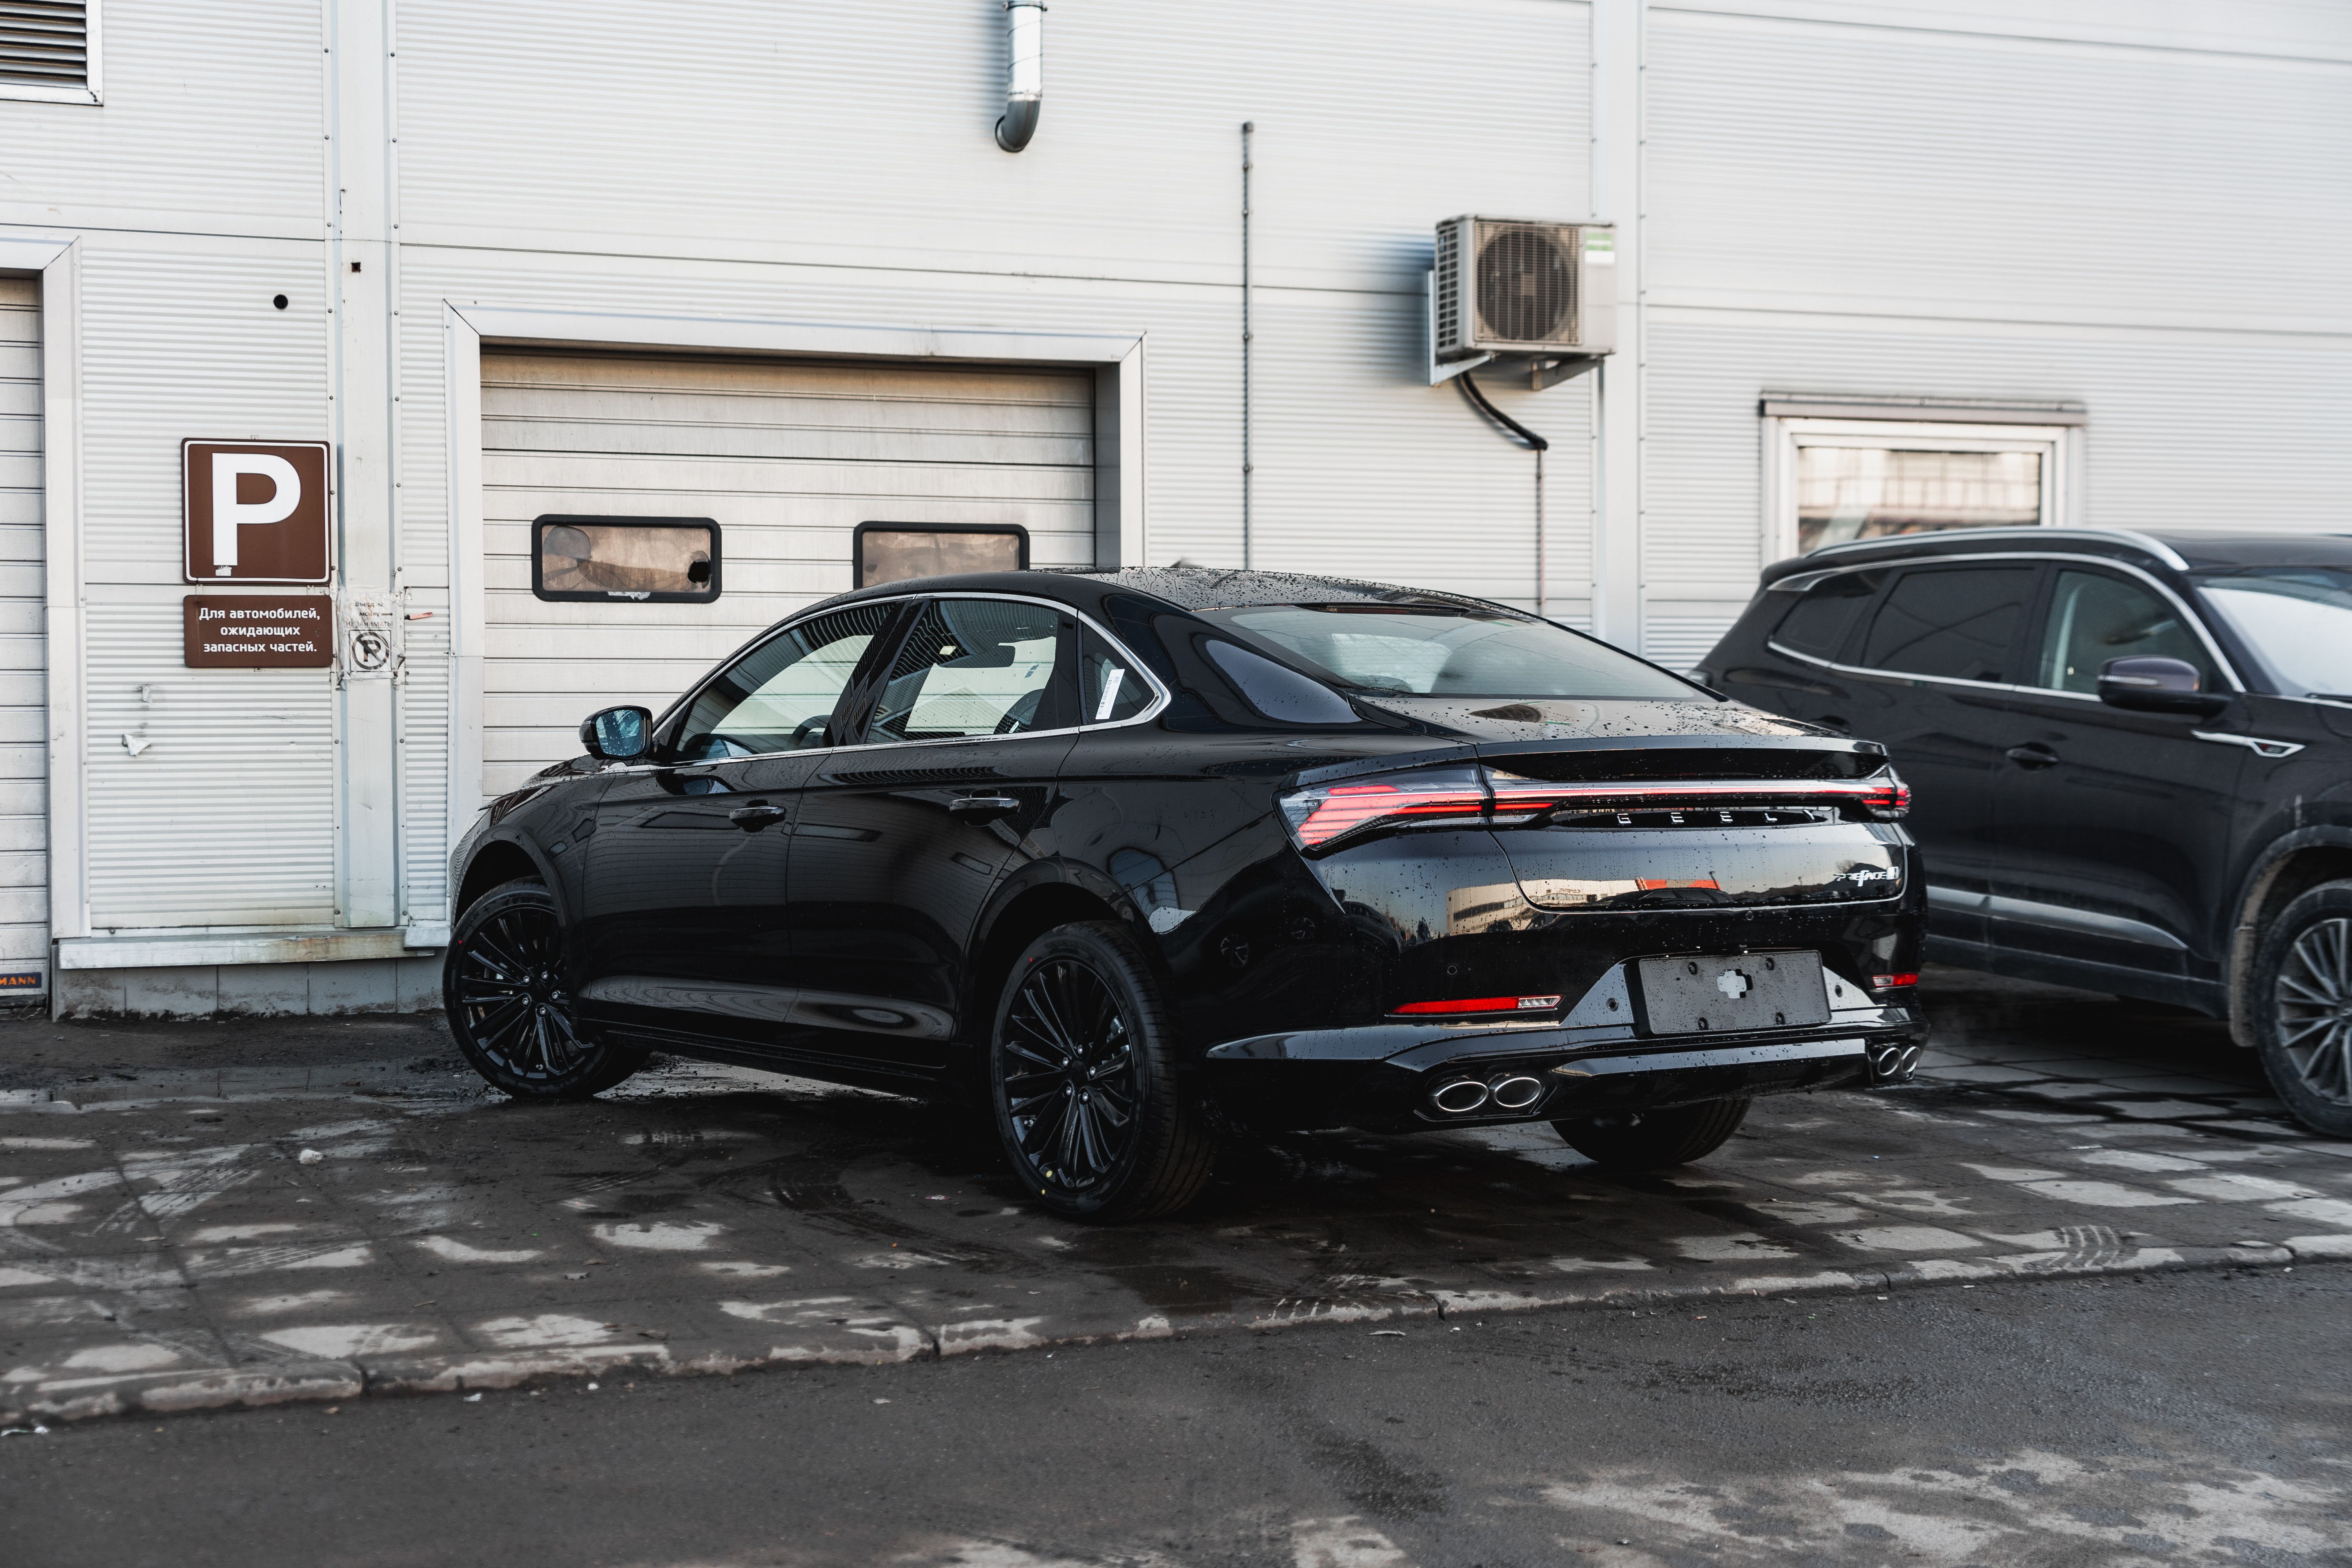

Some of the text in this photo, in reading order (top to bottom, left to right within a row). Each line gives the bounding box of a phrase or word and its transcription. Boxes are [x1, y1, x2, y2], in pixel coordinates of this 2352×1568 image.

[212, 453, 301, 566] P
[199, 608, 320, 620] Для автомобилей,
[220, 627, 300, 637] ожидающих
[203, 641, 317, 652] запасных частей.
[1617, 809, 1815, 824] GEELY
